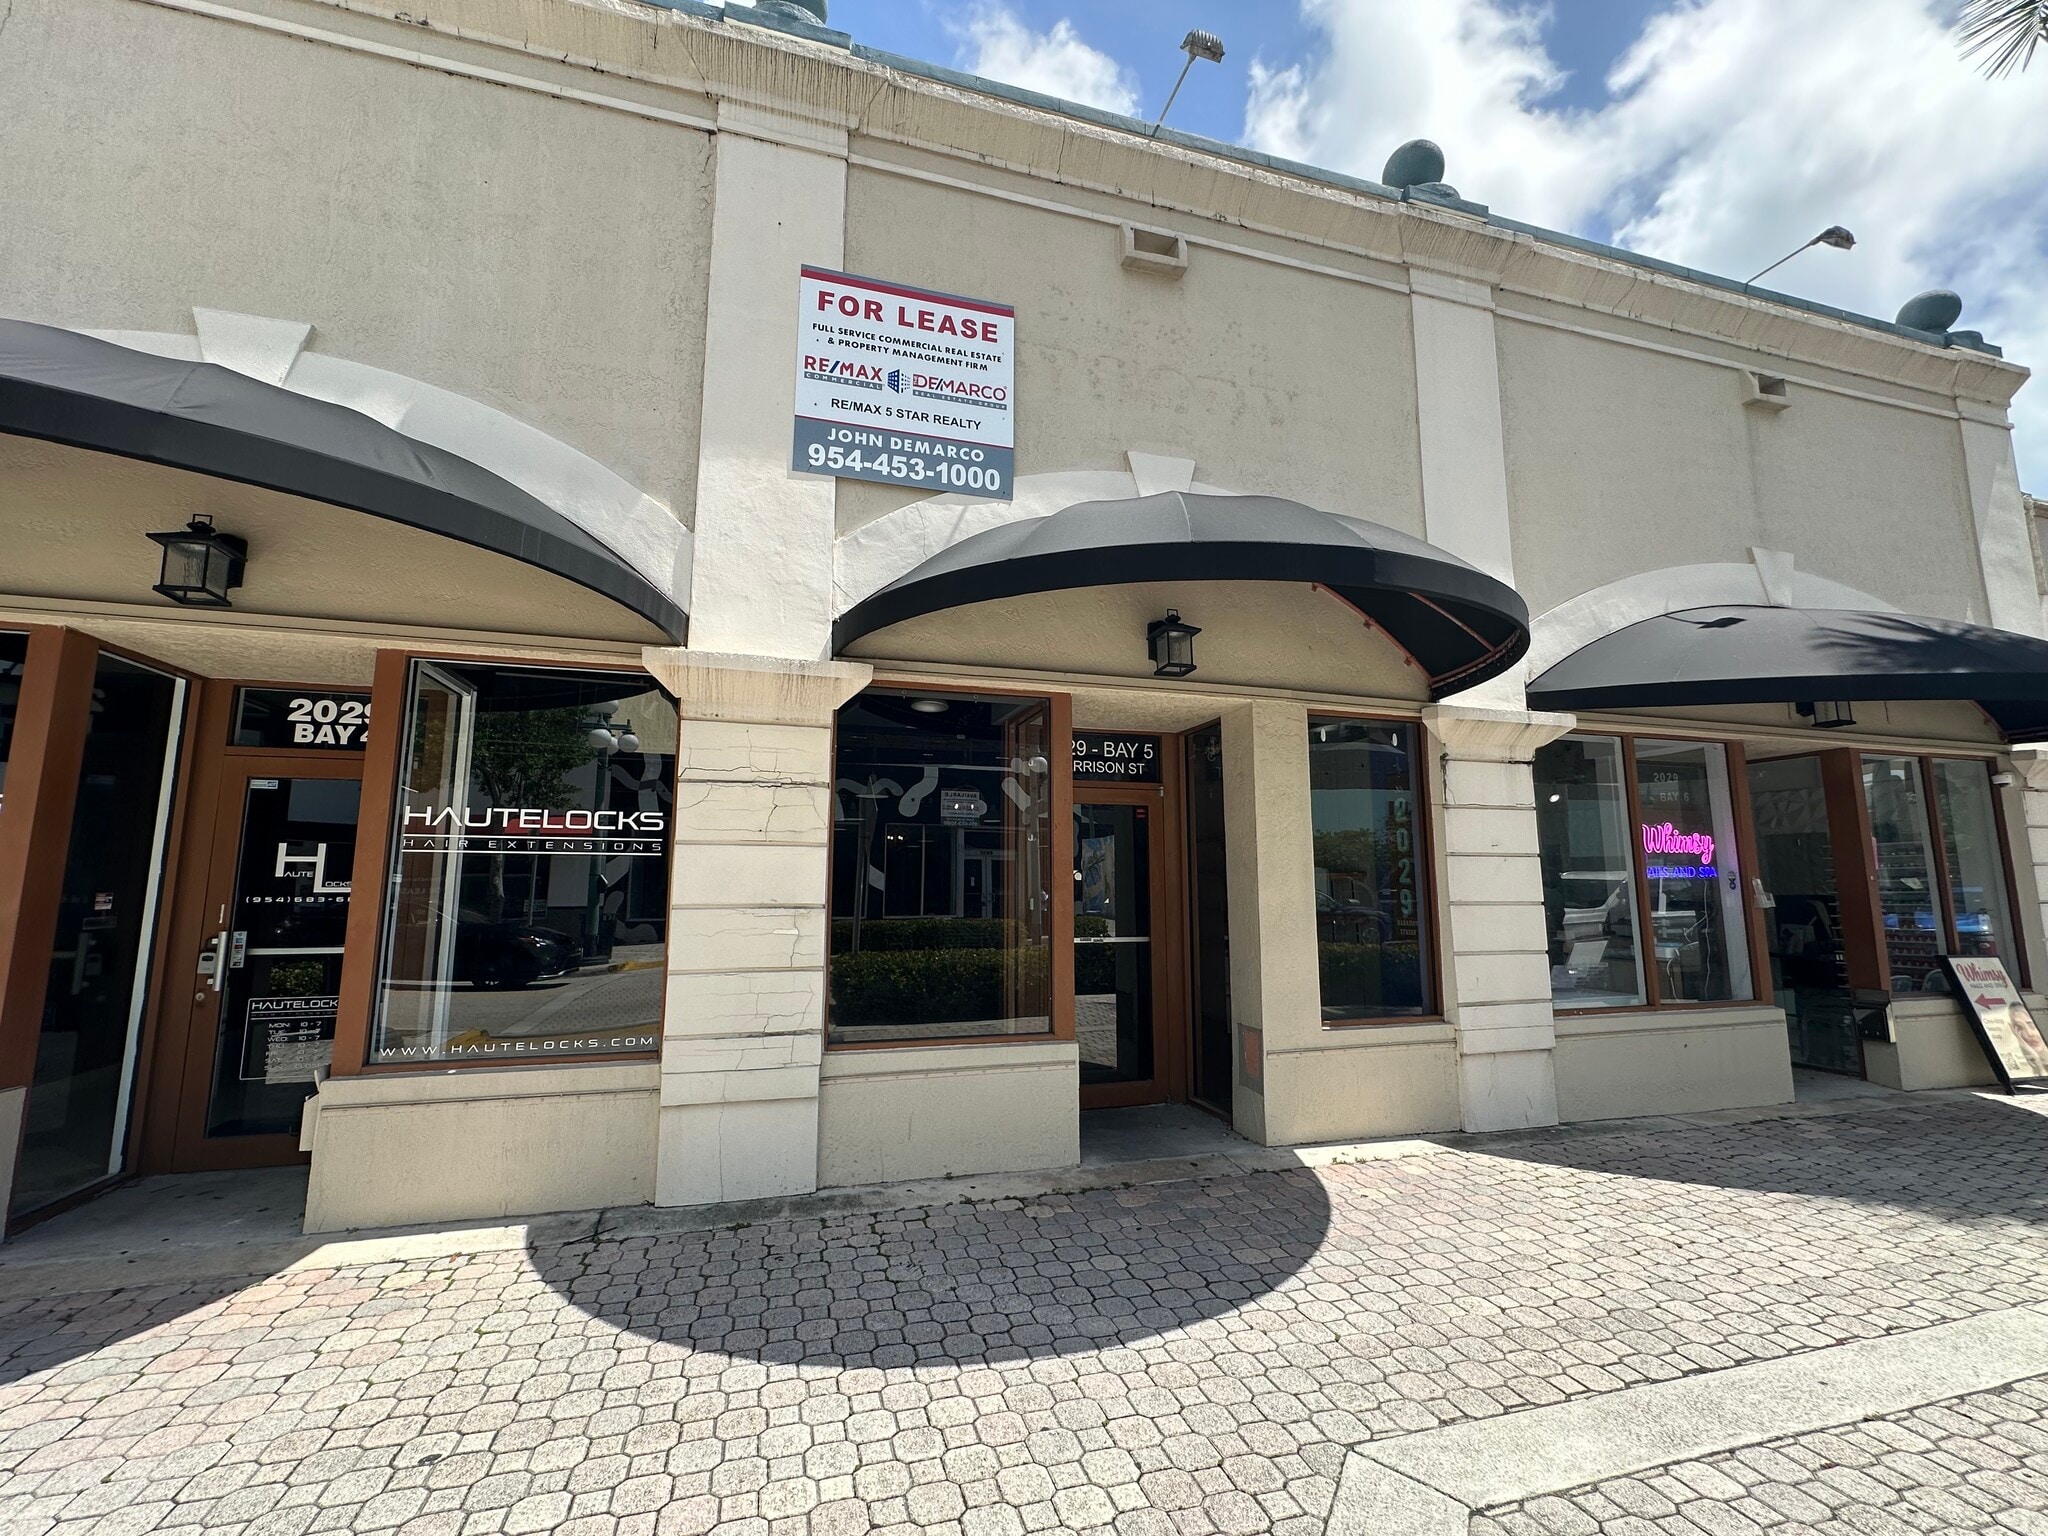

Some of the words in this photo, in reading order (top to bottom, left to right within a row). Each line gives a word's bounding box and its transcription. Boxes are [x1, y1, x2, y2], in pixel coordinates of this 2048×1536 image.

[818, 290, 883, 322] FOR
[898, 306, 998, 343] LEASE
[812, 323, 835, 334] FULL
[838, 327, 876, 341] SERVICE
[879, 335, 942, 353] COMMERCIAL
[945, 347, 968, 358] REAL
[970, 351, 1002, 363] ESTATE
[827, 337, 835, 345] &
[838, 339, 889, 354] PROPERTY
[892, 349, 963, 367] MANAGEMENT
[966, 361, 988, 371] FIRM
[804, 355, 883, 382] RE/MAX
[806, 373, 881, 390] COMMERCIAL
[915, 391, 936, 399] REAL
[941, 395, 973, 405] ESTATE
[979, 401, 1006, 409] GROUP
[831, 398, 882, 416] RE/MAX
[885, 407, 893, 417] 5
[896, 408, 930, 423] STAR
[933, 414, 982, 431] REALTY
[828, 428, 883, 447] JOHN
[890, 438, 984, 462] DEMARCO
[807, 443, 1001, 491] 954-453-1000
[294, 723, 356, 745] BAY
[1104, 741, 1139, 758] BAY
[1143, 744, 1154, 759] 5
[1128, 762, 1145, 775] ST
[1654, 773, 1678, 782] 2029
[1660, 793, 1678, 802] BAY
[1684, 792, 1689, 801] 6
[403, 806, 664, 831] HAUTELOCKS
[403, 839, 468, 849] HAIR
[488, 840, 661, 851] EXTENSIONS
[1642, 822, 1714, 864] Whimsy
[1672, 866, 1696, 878] AND
[1698, 866, 1717, 878] SPA
[1956, 962, 2008, 988] Whimsy
[380, 1037, 654, 1056] WWW.HAUTELOCKS.COM
